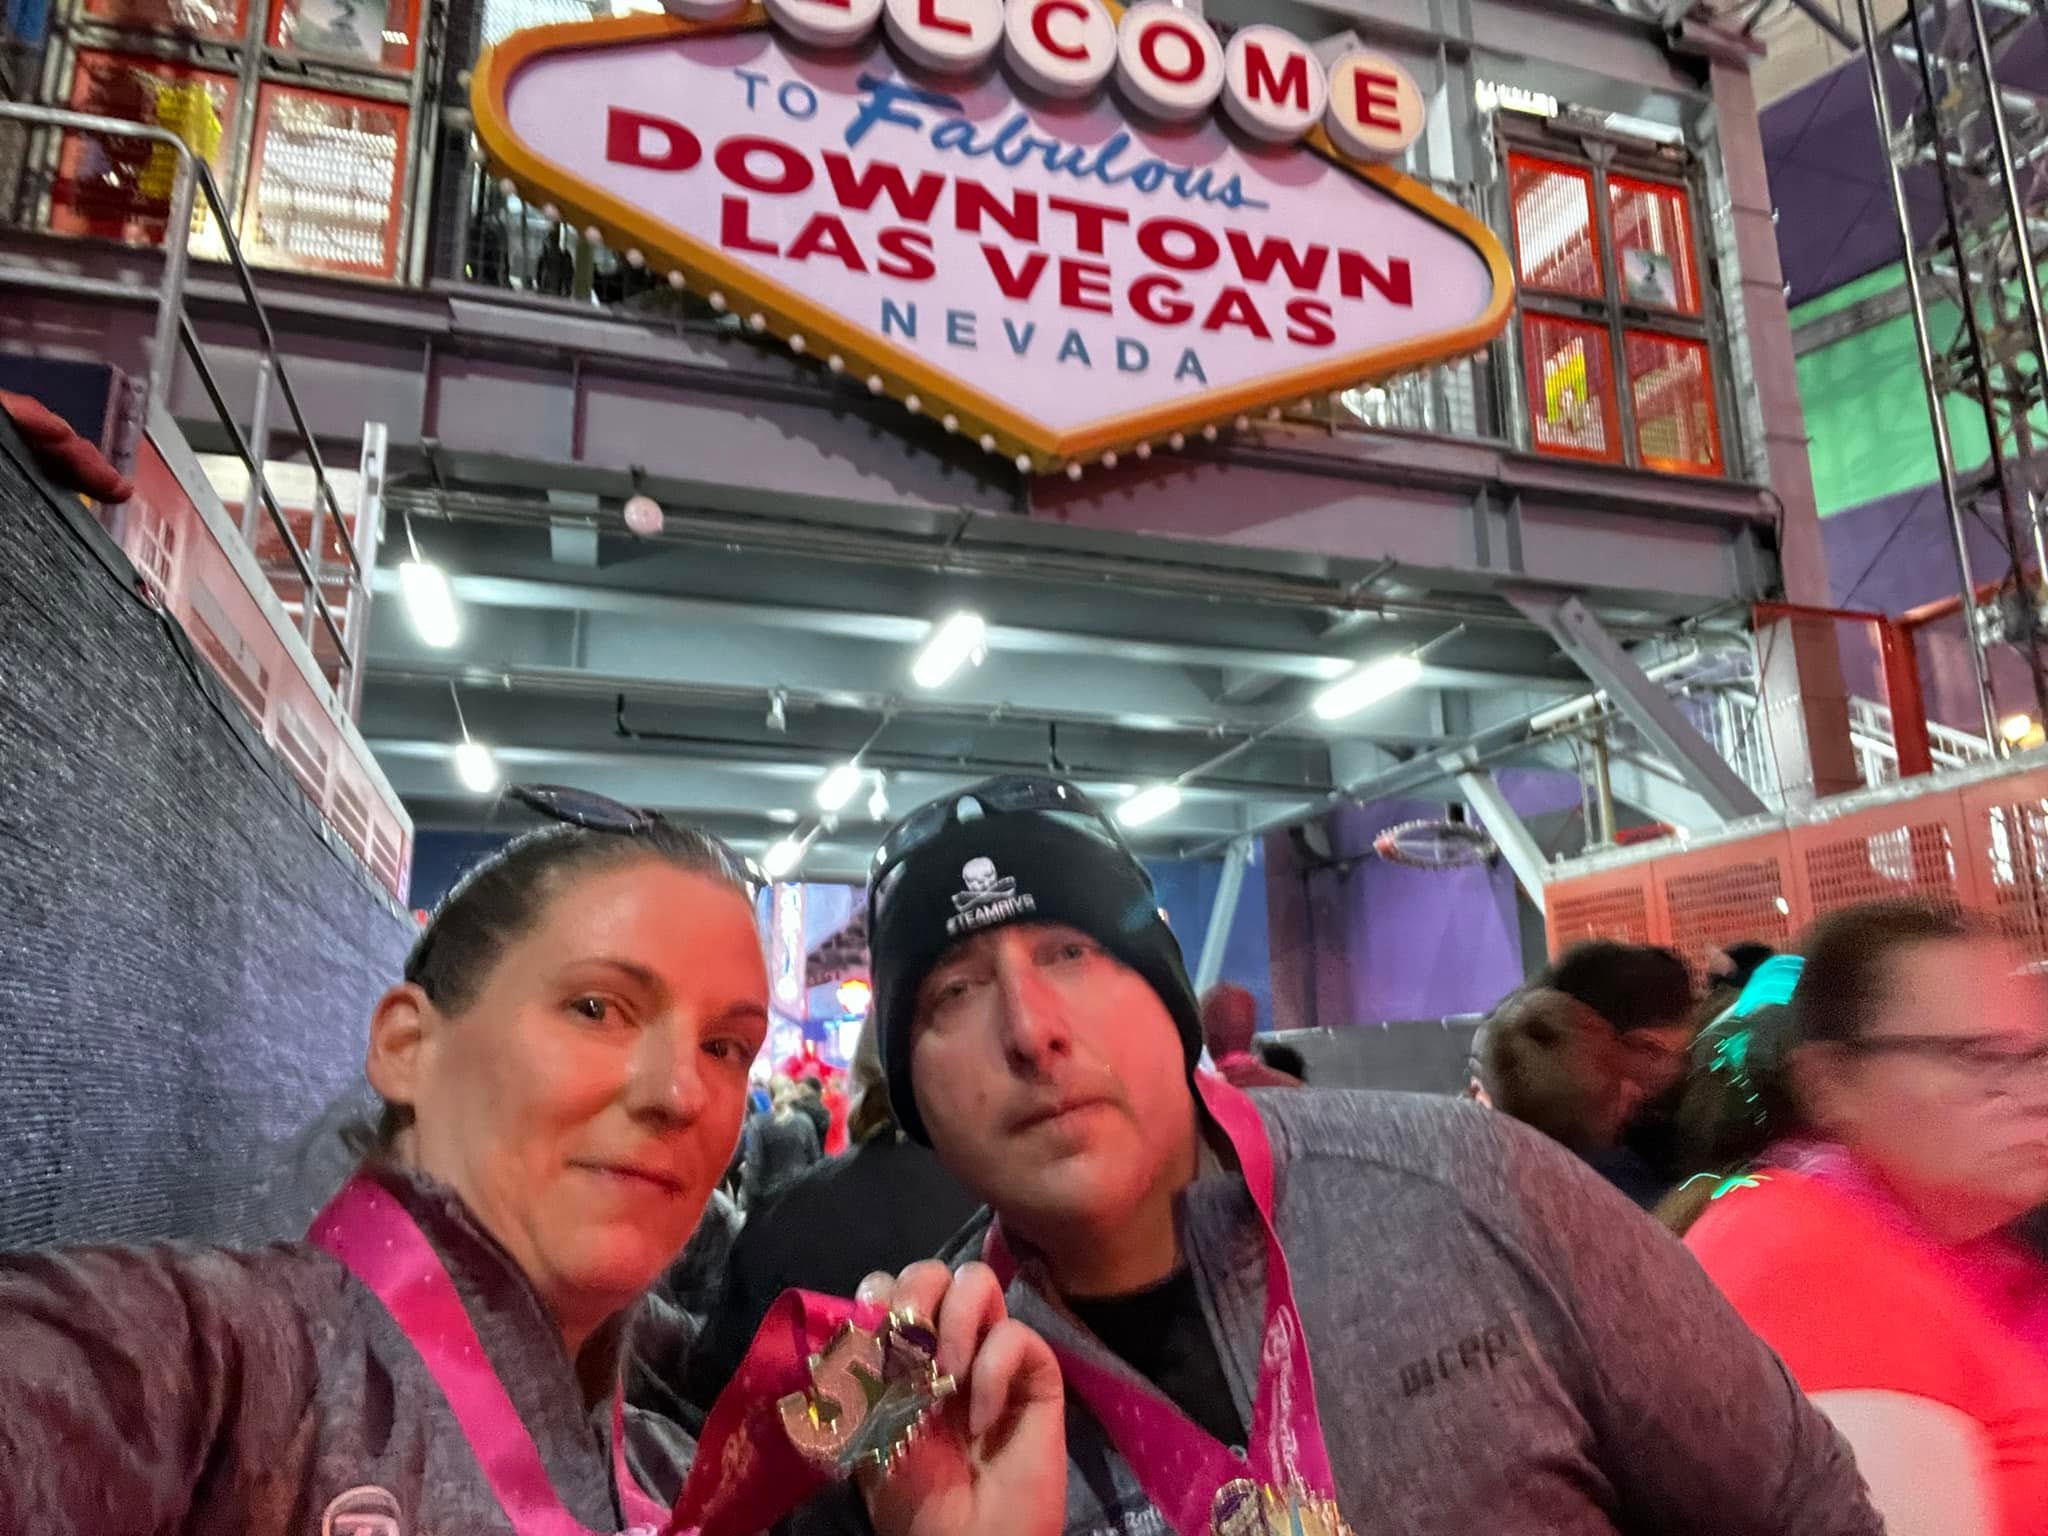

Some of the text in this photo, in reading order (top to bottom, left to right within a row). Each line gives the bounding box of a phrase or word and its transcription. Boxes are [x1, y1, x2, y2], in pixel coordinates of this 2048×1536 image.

[806, 0, 1402, 134] LCOME
[605, 105, 1413, 308] DOWNTOWN
[734, 68, 1269, 210] TO Fabulous
[721, 194, 1337, 347] LAS VEGAS
[880, 297, 1208, 385] NEVADA
